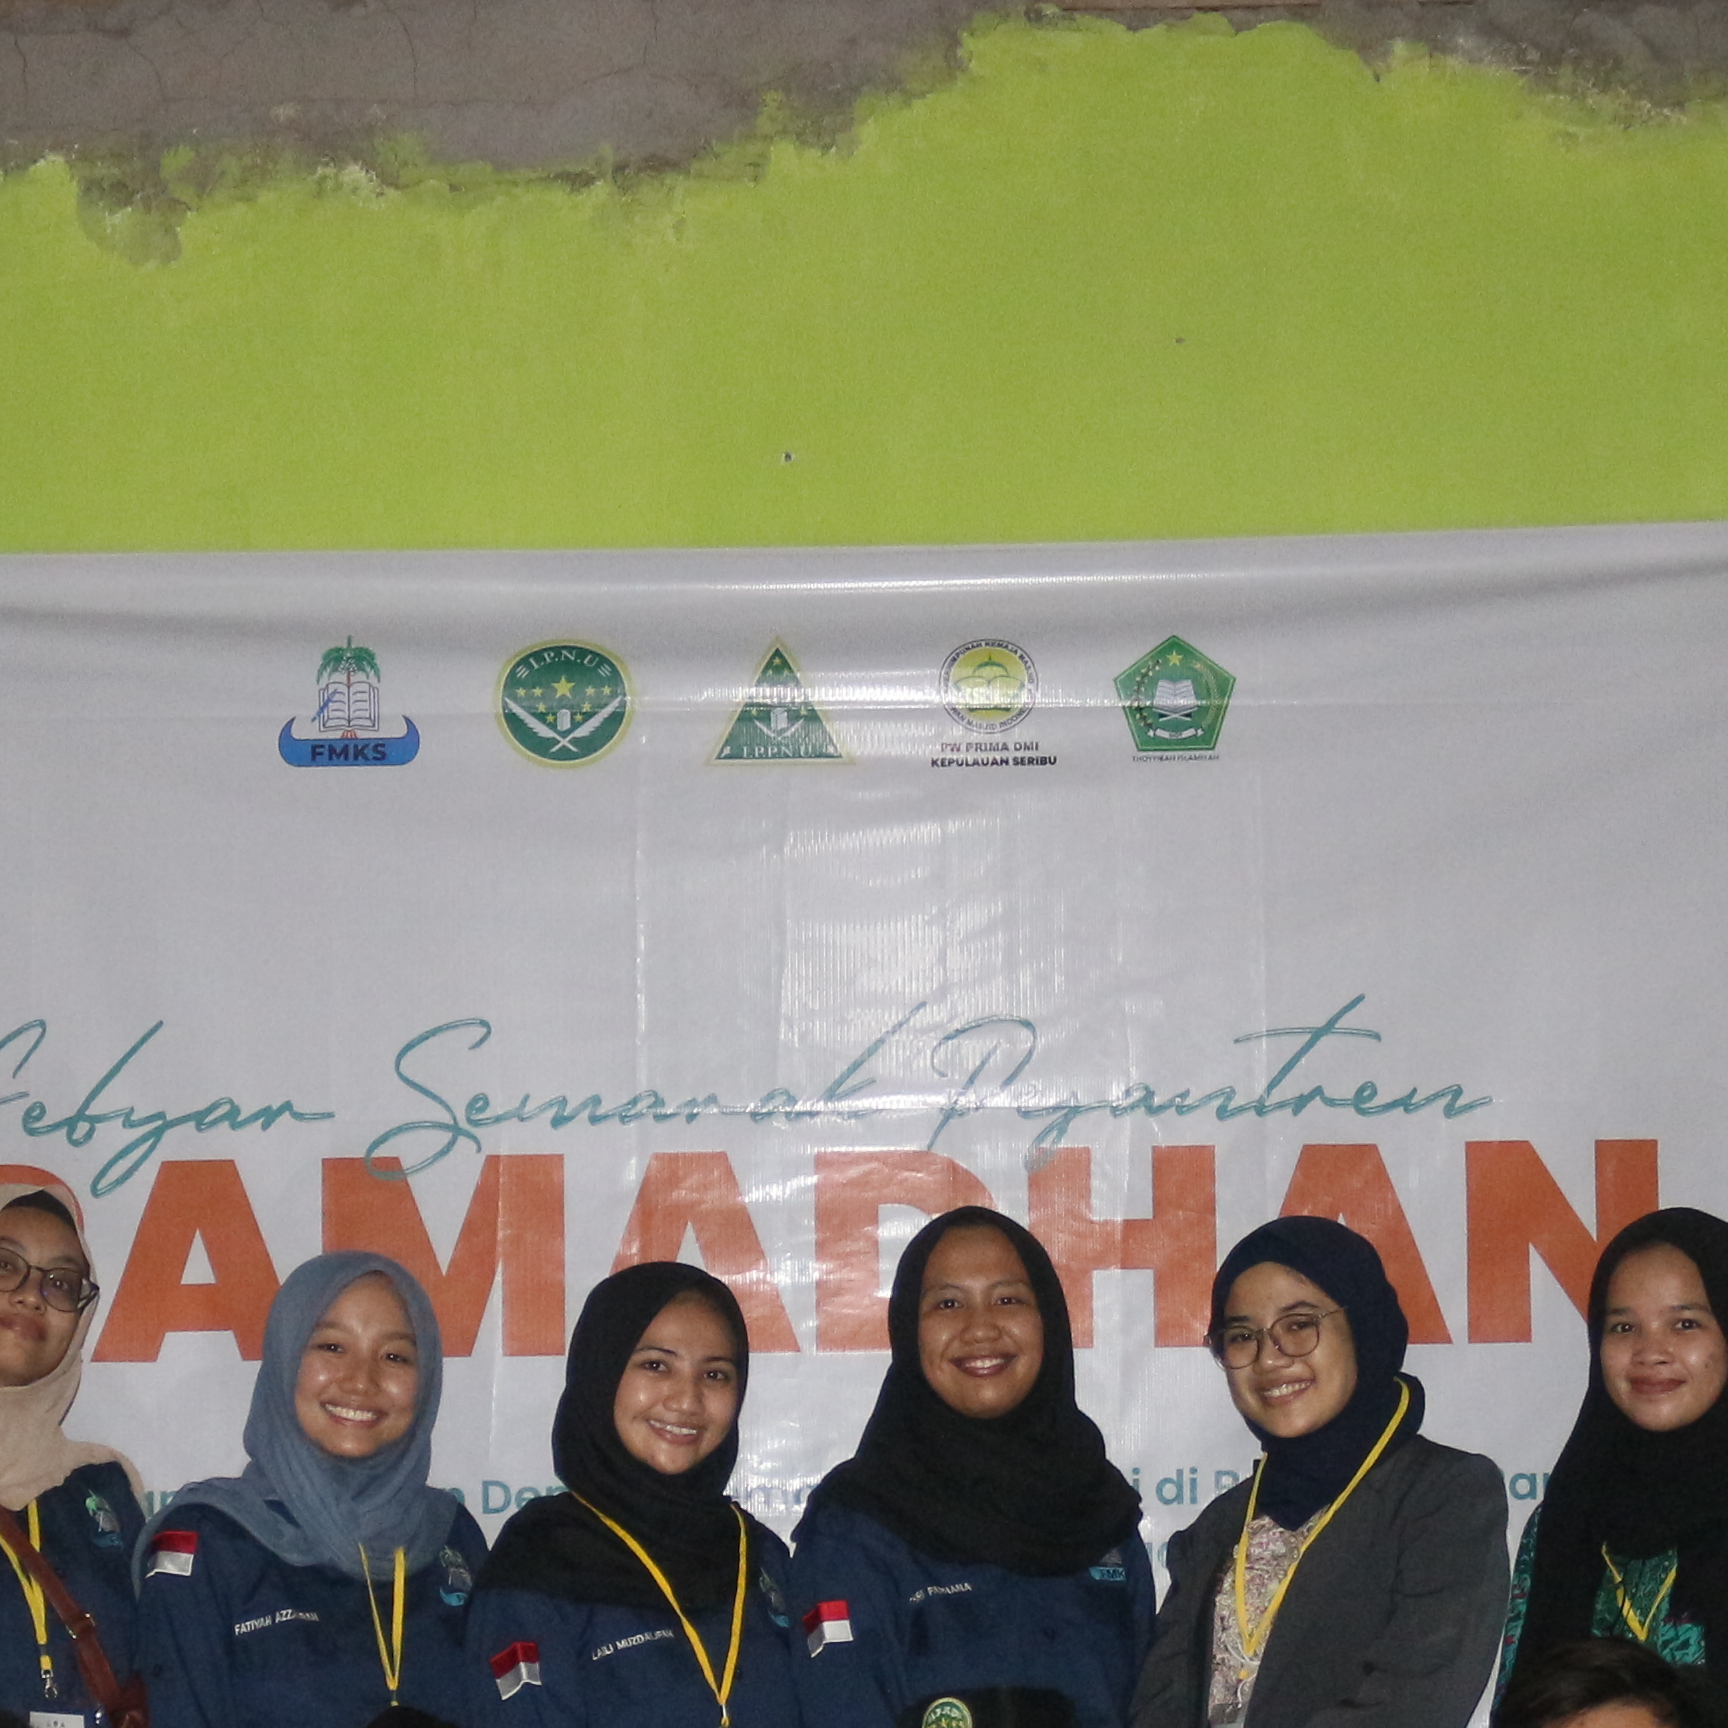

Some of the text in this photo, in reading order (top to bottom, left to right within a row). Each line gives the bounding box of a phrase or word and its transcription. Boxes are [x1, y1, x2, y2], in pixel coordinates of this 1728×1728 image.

[311, 742, 388, 763] FMKS
[965, 741, 1010, 753] PRIMA
[1013, 741, 1040, 752] DMI
[930, 755, 1058, 768] KEPULAUAN SERIBU
[1155, 1466, 1199, 1506] di
